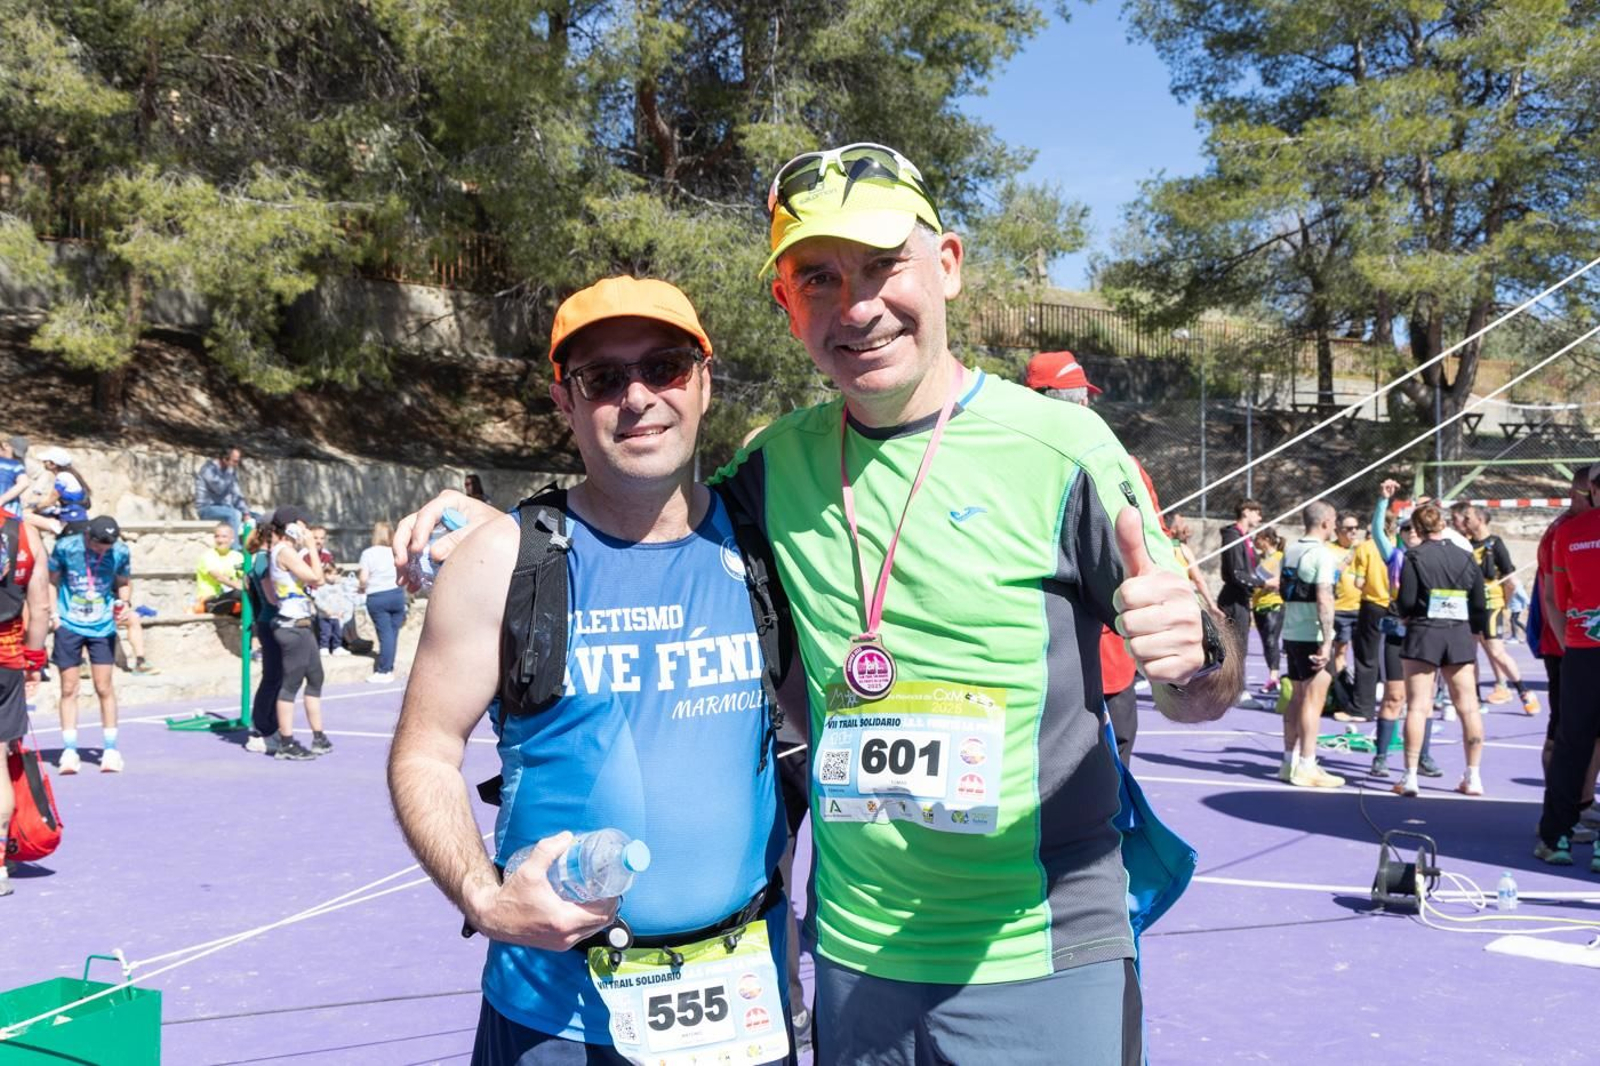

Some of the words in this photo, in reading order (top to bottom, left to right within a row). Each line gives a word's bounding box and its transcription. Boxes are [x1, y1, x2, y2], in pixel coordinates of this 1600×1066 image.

[568, 604, 684, 634] LETISMO
[671, 687, 769, 720] MARMOLE
[827, 719, 838, 729] VII
[839, 718, 858, 729] TRAIL
[859, 717, 901, 728] SOLIDARIO
[861, 738, 941, 776] 601
[608, 977, 634, 989] TRAIL
[635, 971, 682, 987] SOLIDARIO
[647, 985, 729, 1032] 555
